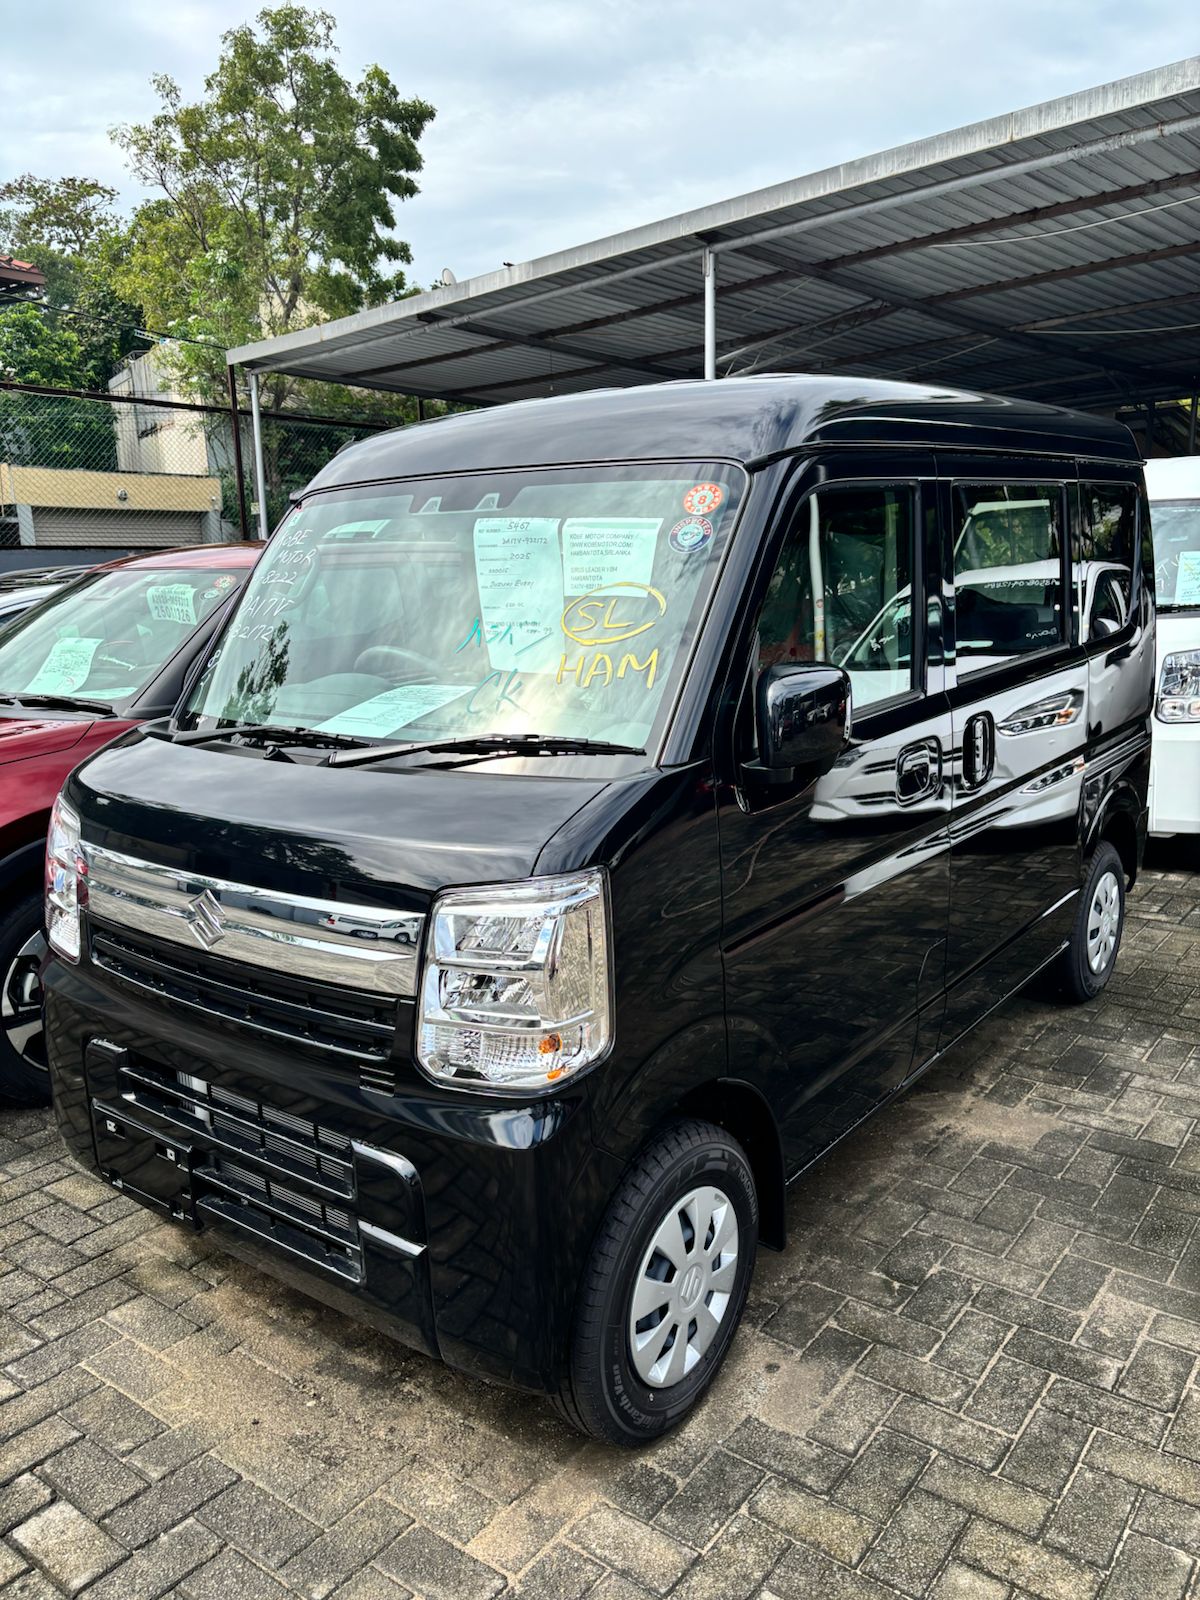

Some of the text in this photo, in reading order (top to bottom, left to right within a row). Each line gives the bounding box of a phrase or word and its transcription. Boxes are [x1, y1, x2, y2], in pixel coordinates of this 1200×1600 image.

[697, 495, 707, 505] 8
[671, 516, 711, 536] INSPECTED
[571, 599, 634, 632] SL
[556, 648, 660, 689] HAM
